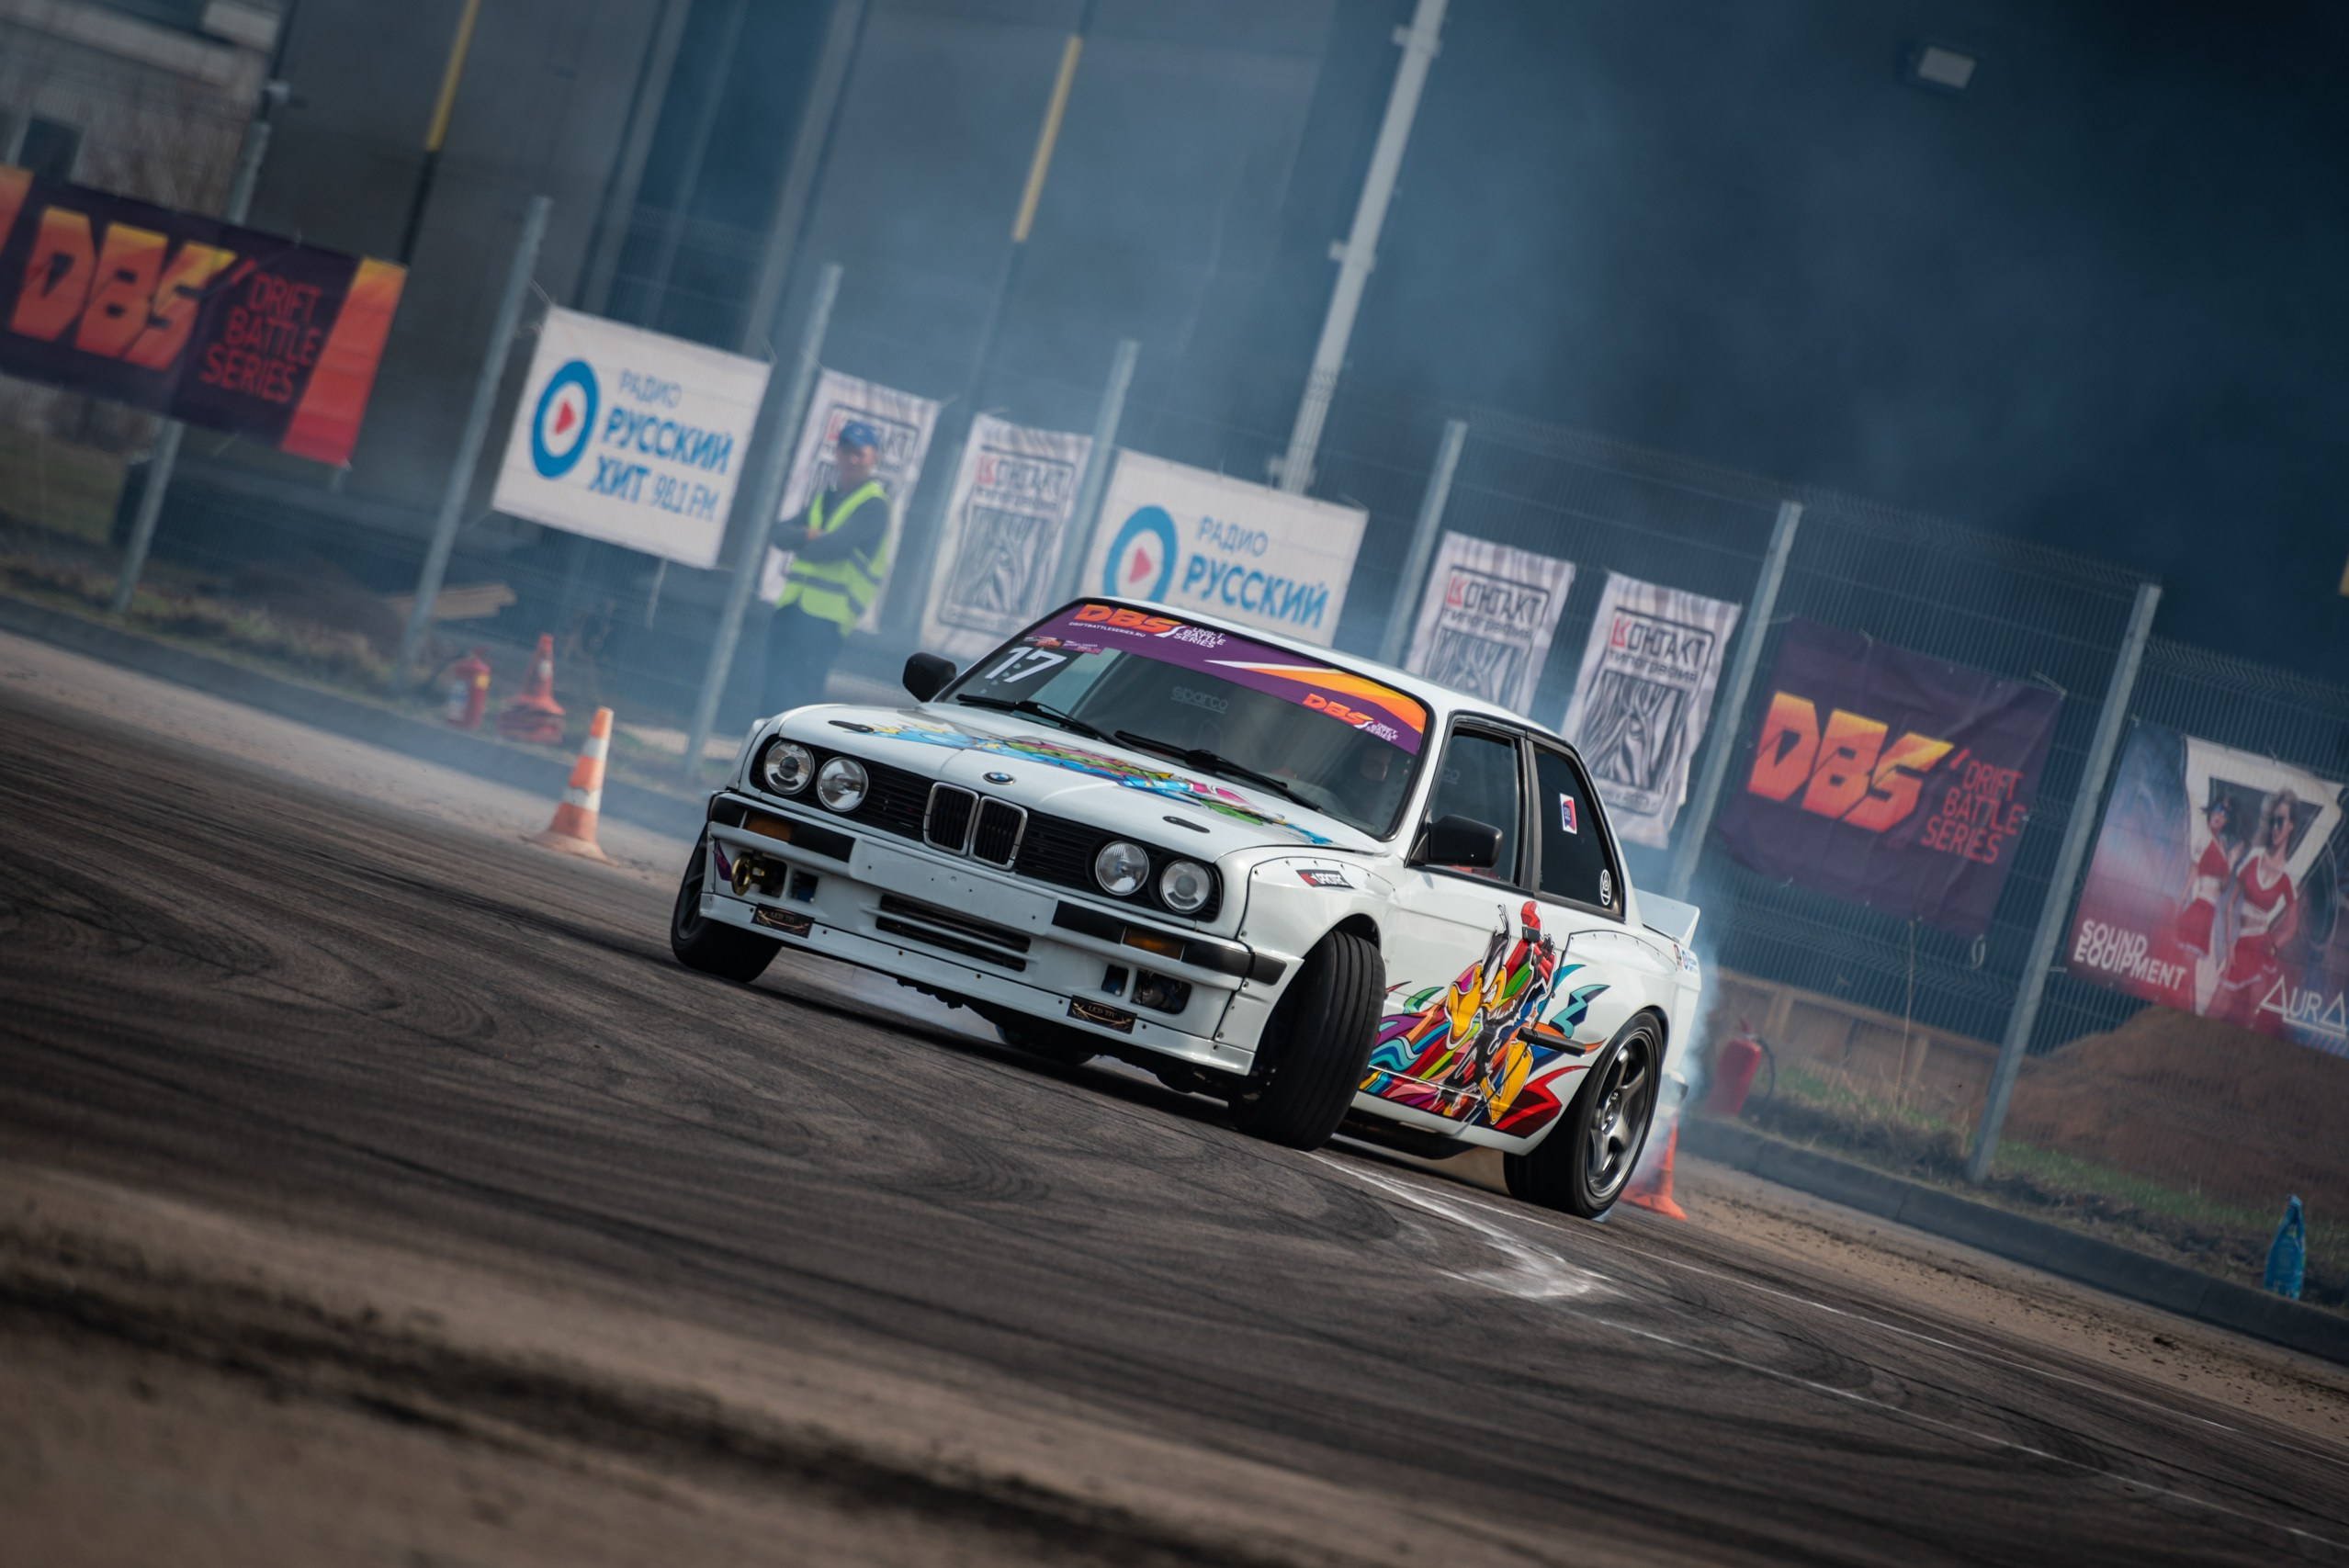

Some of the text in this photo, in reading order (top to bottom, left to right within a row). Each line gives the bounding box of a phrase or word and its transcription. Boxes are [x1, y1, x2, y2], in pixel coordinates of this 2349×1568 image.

[9, 204, 238, 372] DBS
[247, 272, 322, 324] DRIFT
[224, 306, 322, 367] BATTLE
[199, 342, 298, 404] SERIES
[618, 367, 683, 410] РАДИО
[600, 405, 734, 476] РУССКИЙ
[587, 453, 652, 503] ХИТ
[1196, 514, 1269, 558] РАДИО
[1180, 553, 1330, 629] РУССКИЙ
[1073, 604, 1183, 634] DBS
[985, 646, 1067, 683] 17
[1302, 693, 1375, 726] DBS
[1747, 690, 1955, 833] DBS
[1962, 759, 2025, 802] DRIFT
[1942, 785, 2027, 836] BATTLE
[1920, 814, 2003, 864] SERIES
[2072, 934, 2187, 991] EQUIPMENT
[2081, 919, 2149, 958] SOUND
